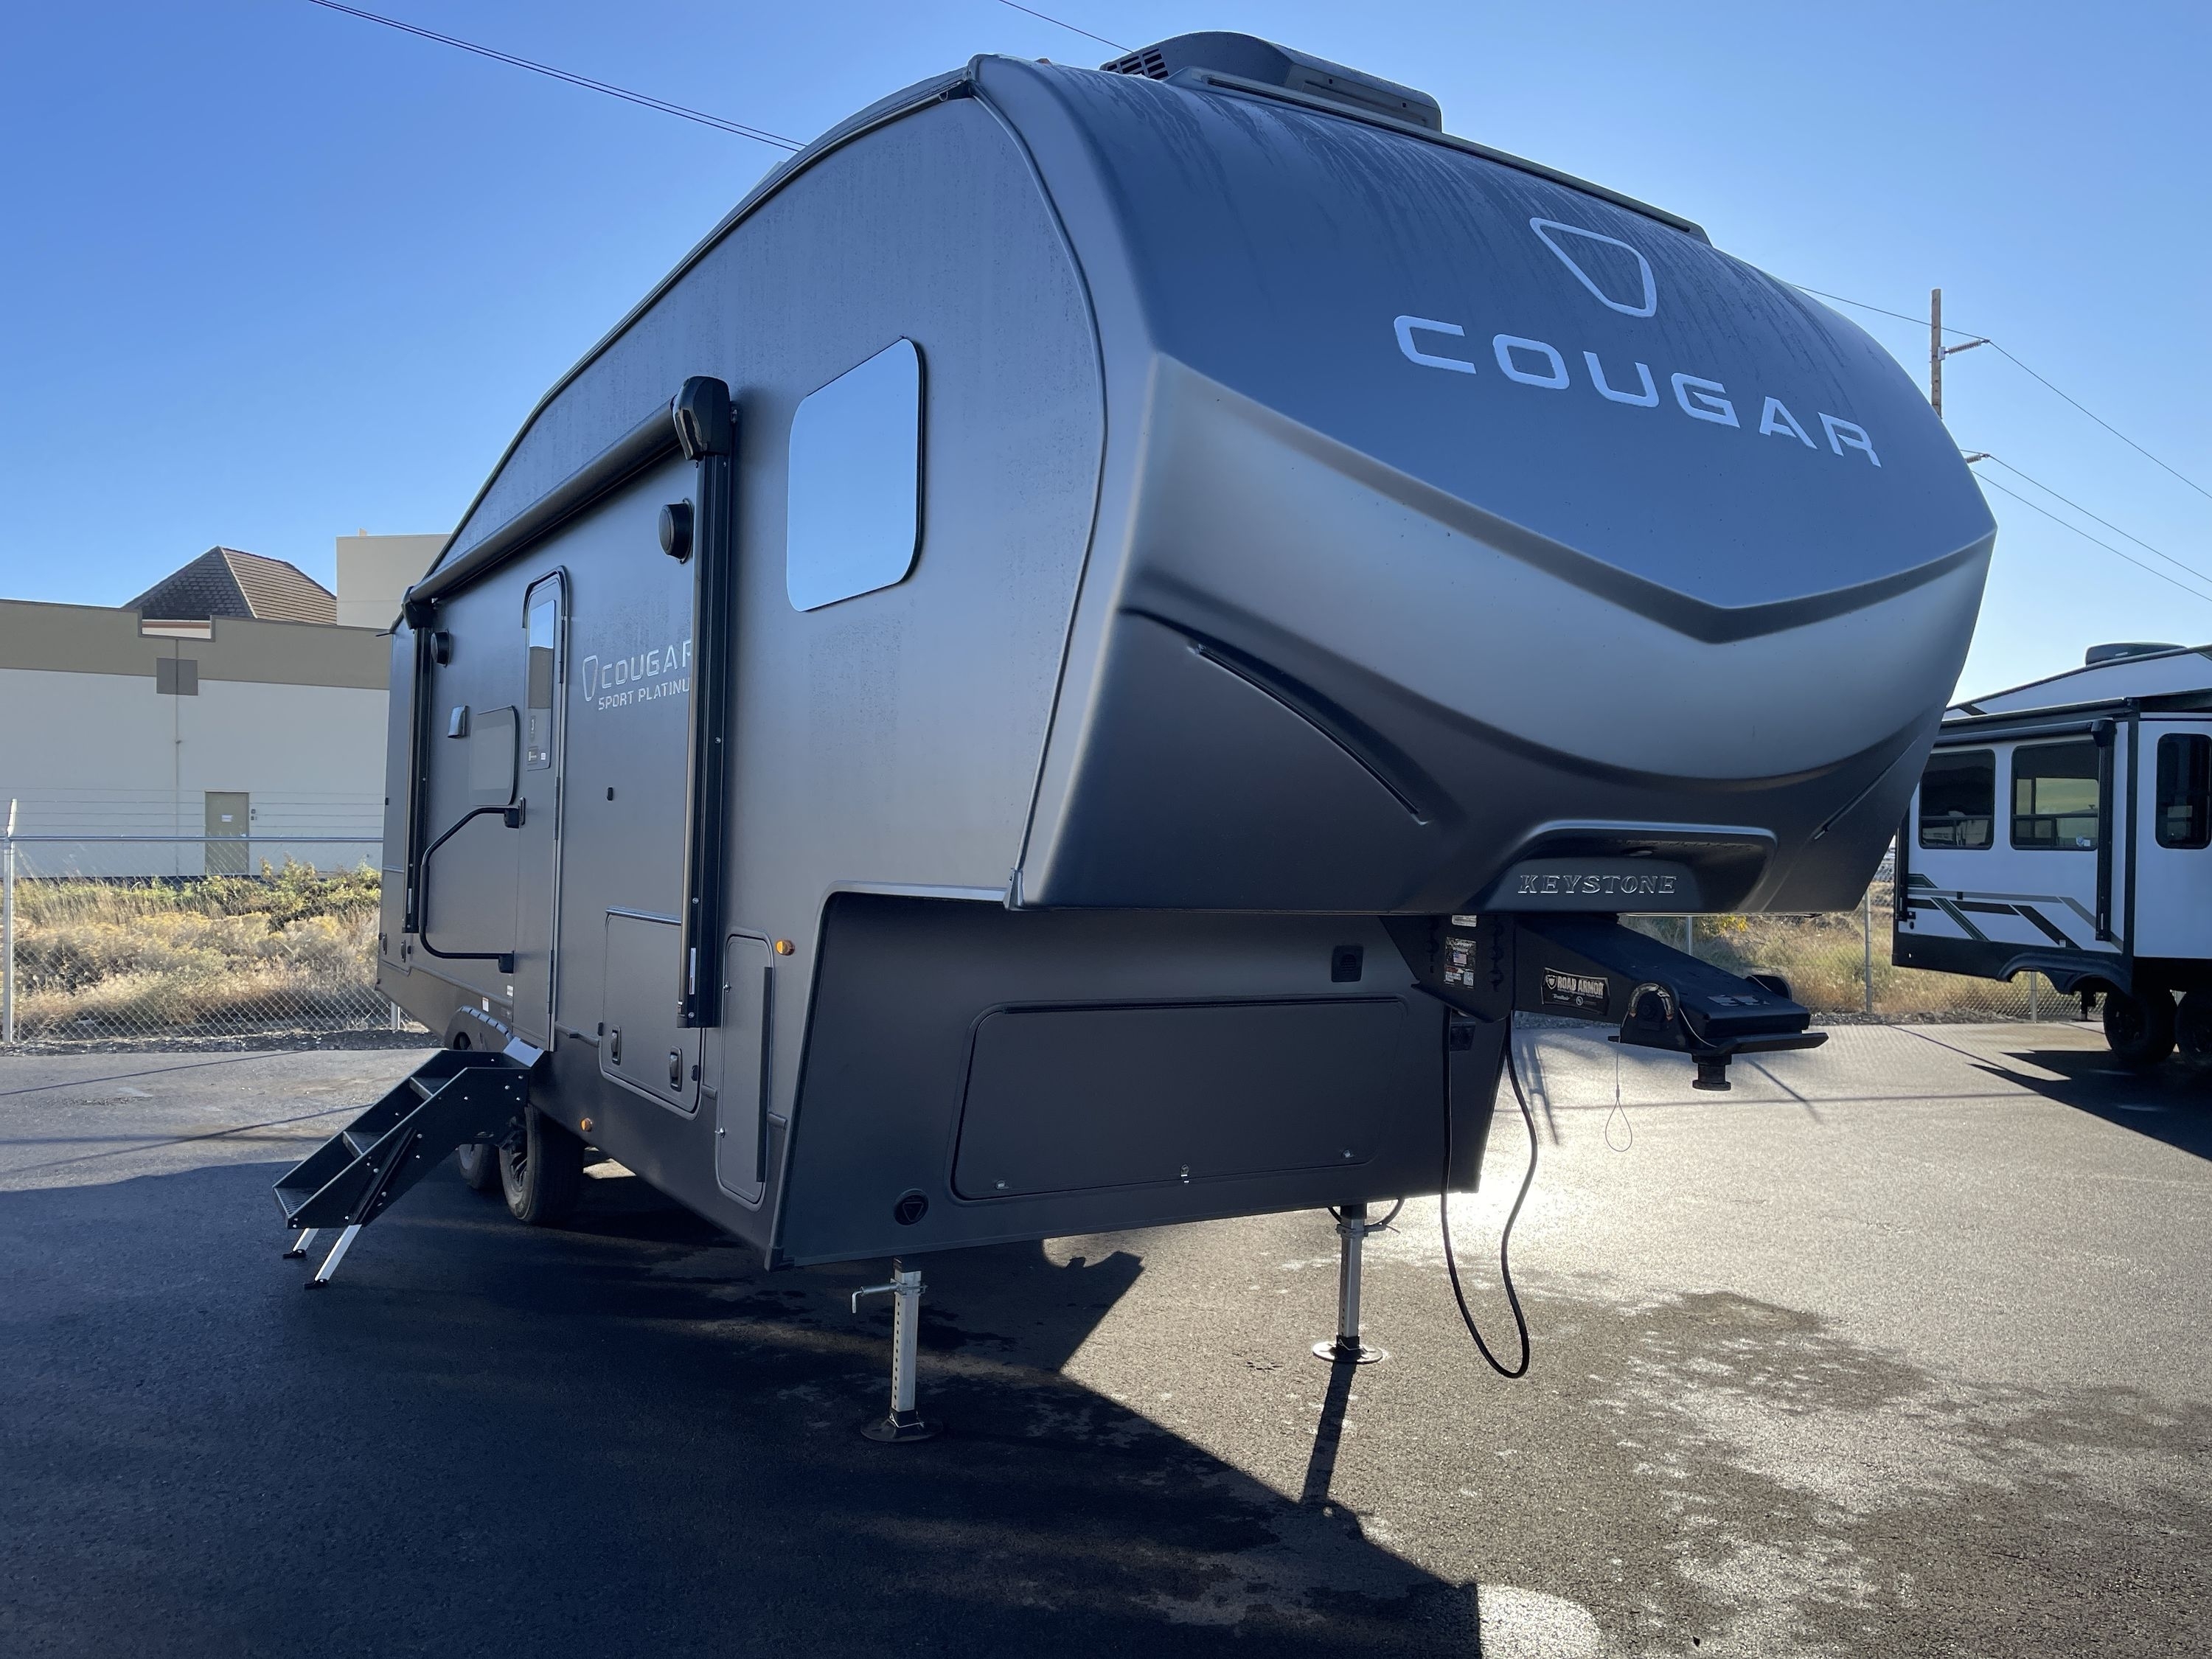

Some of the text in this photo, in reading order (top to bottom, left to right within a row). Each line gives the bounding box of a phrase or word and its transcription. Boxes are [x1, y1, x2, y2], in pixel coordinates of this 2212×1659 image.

[1394, 315, 1882, 468] COUGAR
[598, 676, 691, 711] SPORT PLATINU
[1517, 874, 1677, 894] KEYSTONE
[1557, 975, 1577, 991] ROAD
[1578, 979, 1604, 996] ARMOR
